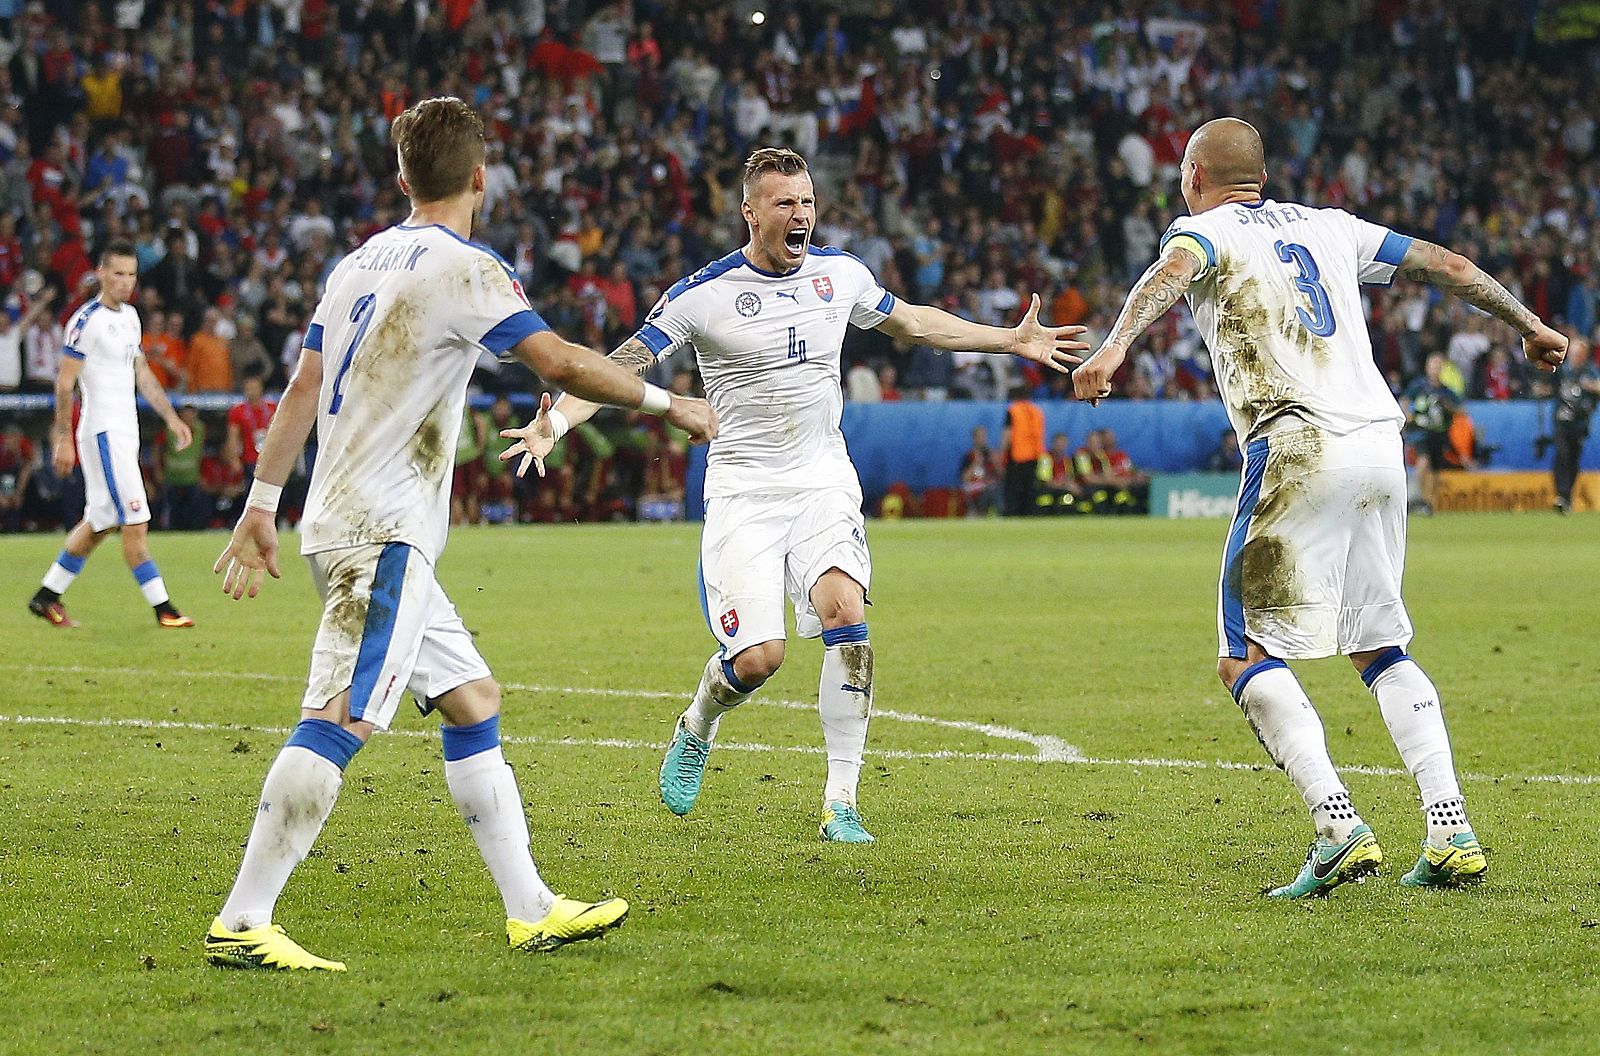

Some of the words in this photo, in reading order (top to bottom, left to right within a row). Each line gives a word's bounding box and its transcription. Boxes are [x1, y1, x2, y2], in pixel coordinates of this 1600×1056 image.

[1273, 239, 1336, 337] 3
[328, 292, 377, 415] 2
[787, 326, 807, 364] 4
[1413, 700, 1434, 712] SVK
